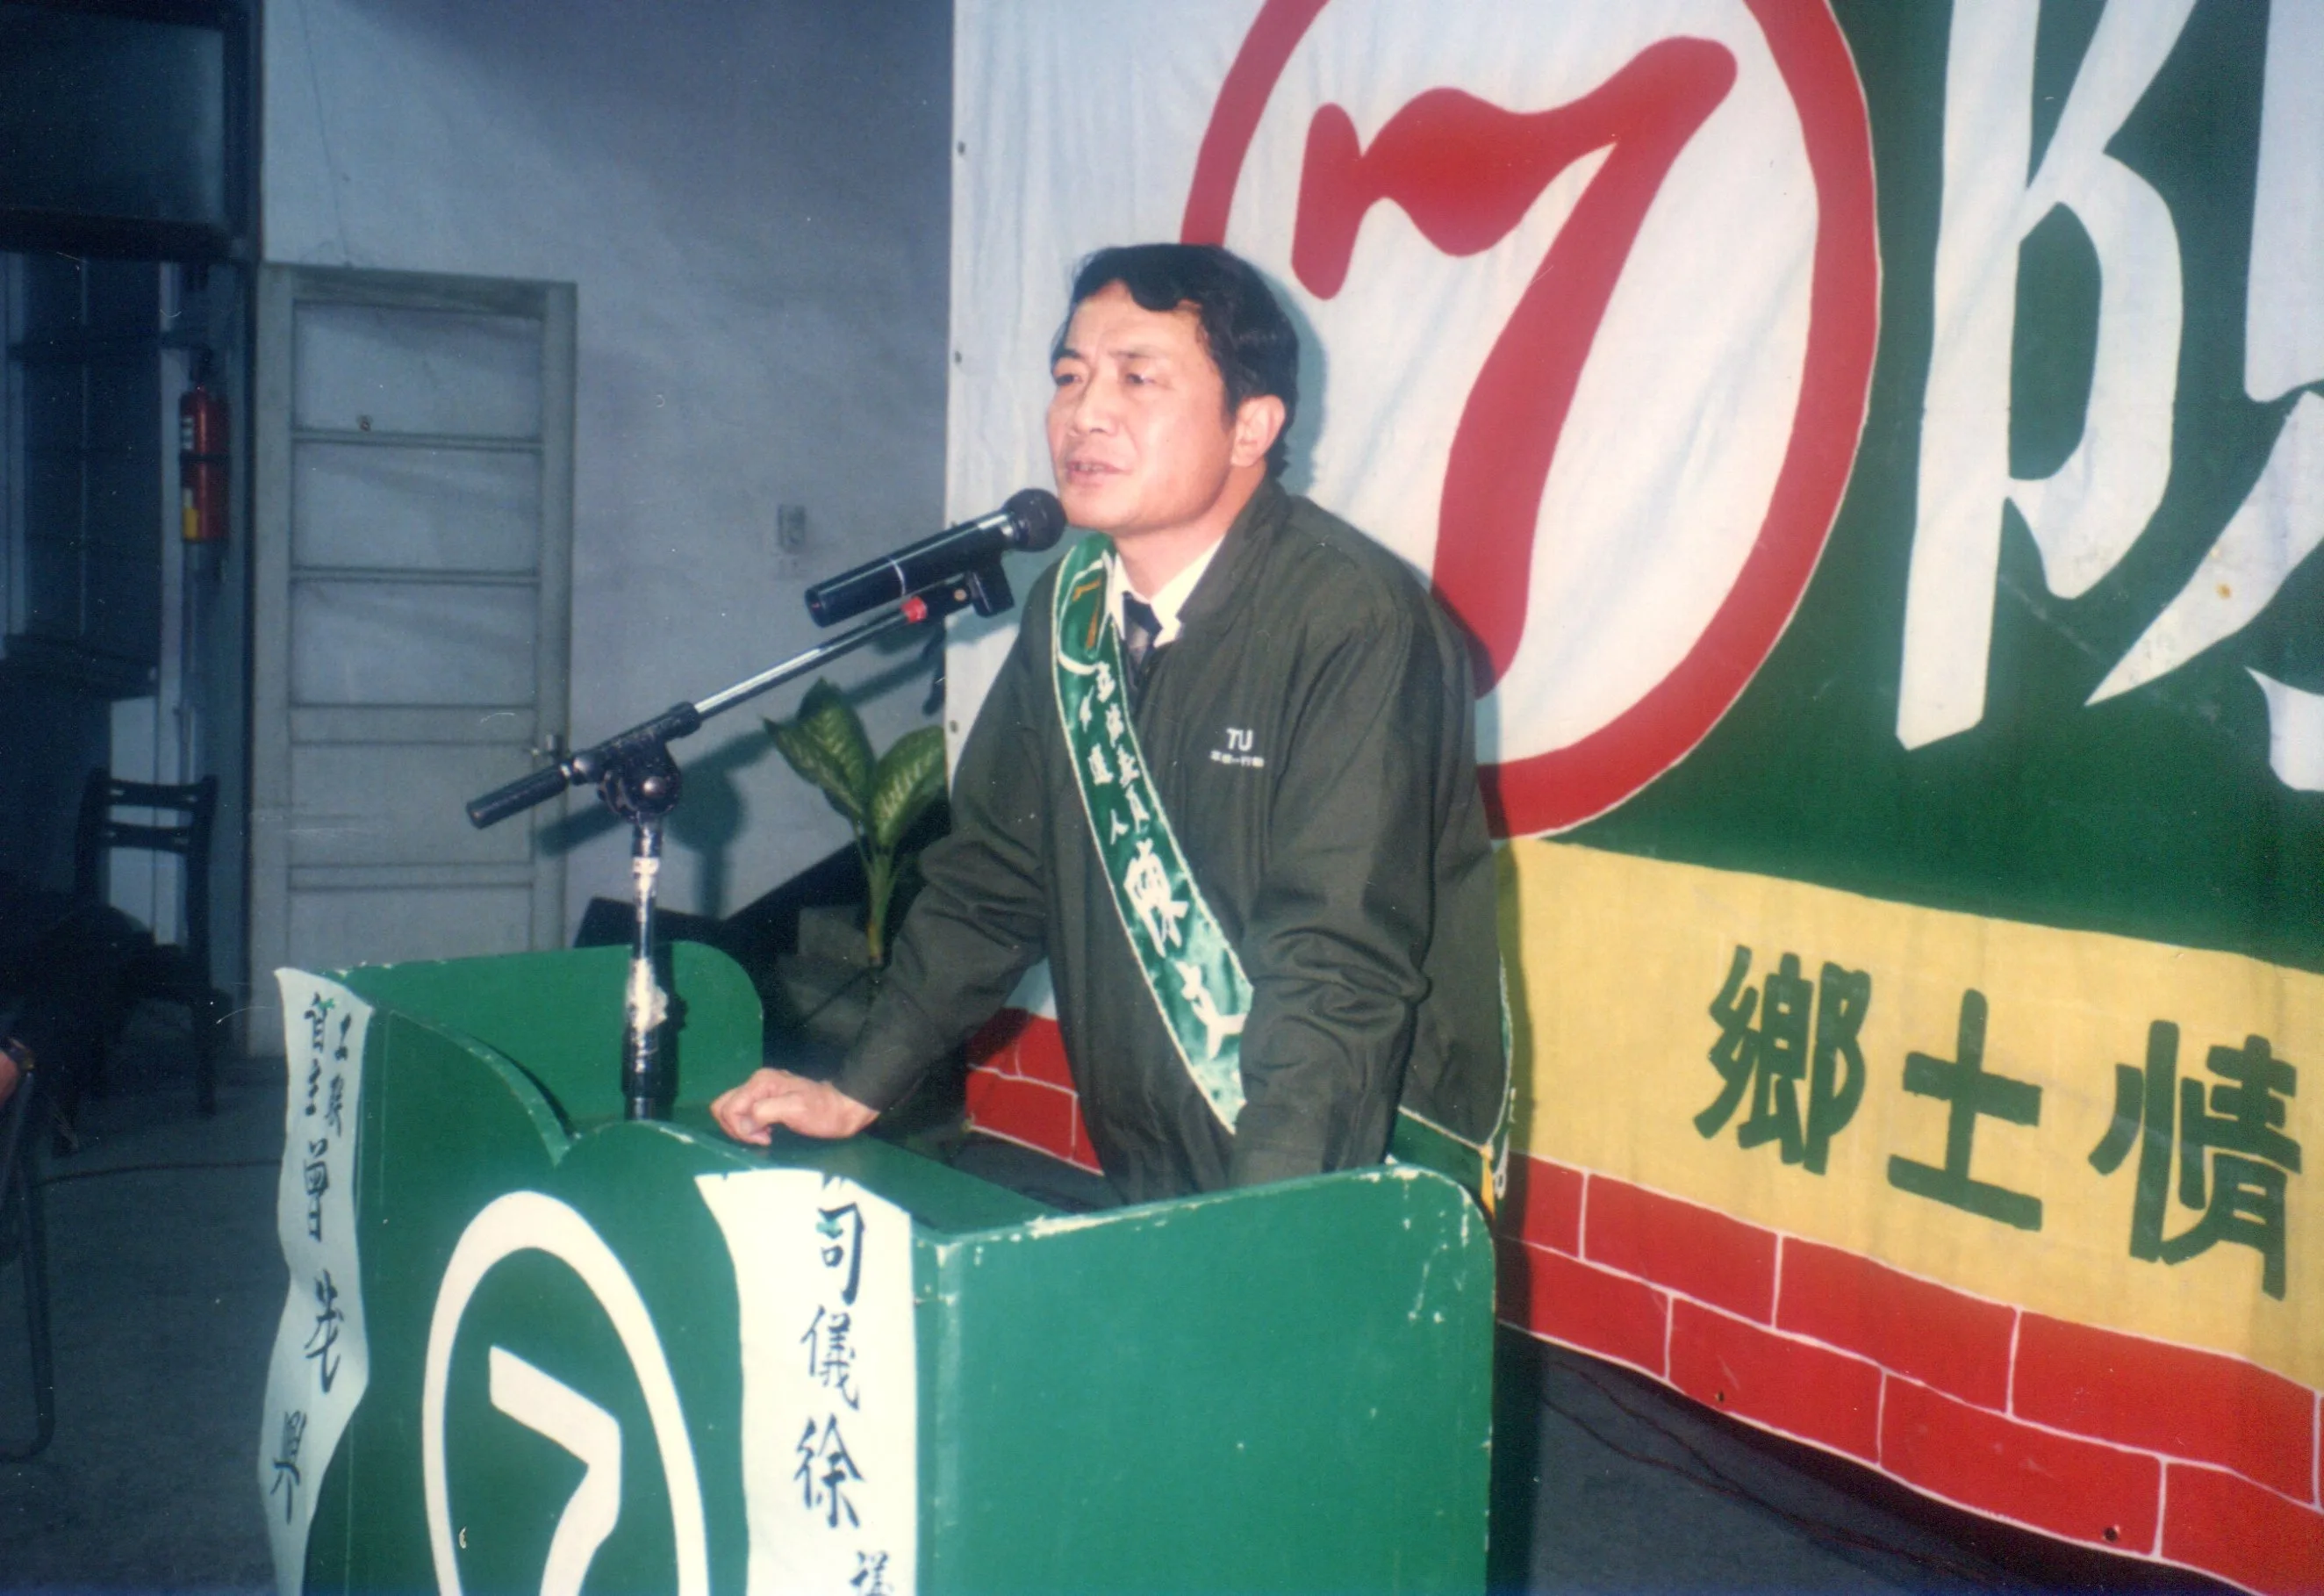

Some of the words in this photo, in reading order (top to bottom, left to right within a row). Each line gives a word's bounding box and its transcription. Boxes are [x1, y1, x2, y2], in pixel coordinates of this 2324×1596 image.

[1292, 35, 1737, 700] 7
[1226, 728, 1253, 751] TU
[1693, 944, 2302, 1302] 鄉土情
[489, 1345, 621, 1596] 7
